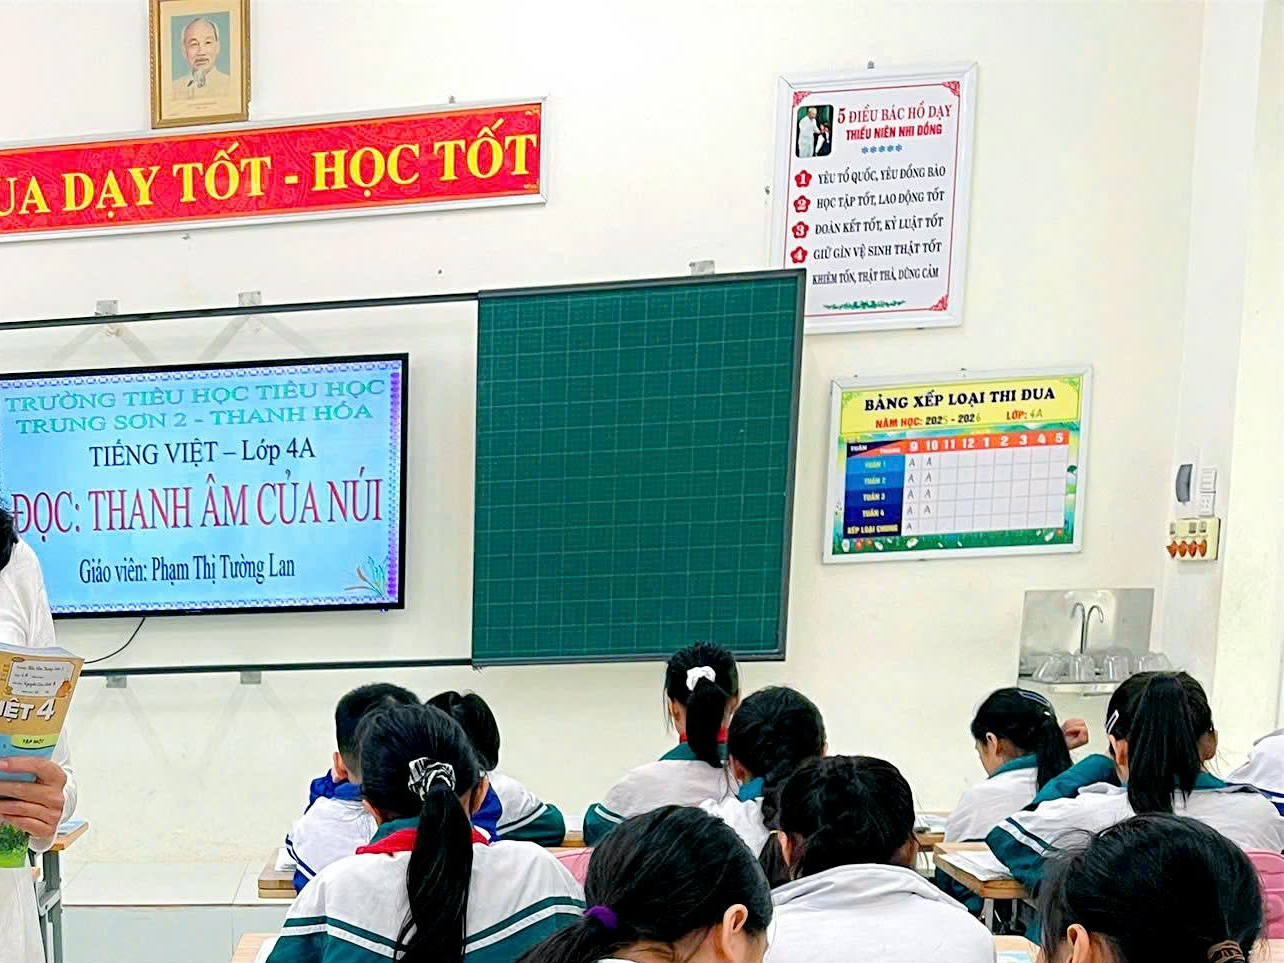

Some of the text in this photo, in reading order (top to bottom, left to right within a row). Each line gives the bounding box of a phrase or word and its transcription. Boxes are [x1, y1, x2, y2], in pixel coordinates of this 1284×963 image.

[838, 101, 951, 124] 5 ĐIỀU BÁC HỒ DẠY
[874, 125, 895, 138] NIÊN
[899, 127, 914, 136] NHI
[61, 166, 161, 218] DẠY
[173, 141, 272, 202] TỐT
[311, 144, 420, 198] HỌC
[434, 118, 538, 181] TỐT
[818, 170, 835, 184] YÊU
[880, 166, 898, 180] YÊU
[817, 198, 836, 211] HỌC
[838, 194, 856, 209] TẬP
[879, 194, 897, 204] LAO
[898, 190, 924, 206] ĐỘNG
[927, 187, 945, 201] TỐT
[843, 218, 861, 233] KẾT
[899, 215, 923, 231] LUẬT
[925, 213, 943, 228] TỐT
[868, 245, 892, 256] SINH
[895, 241, 920, 256] THẬT
[923, 238, 942, 252] TỐT
[5, 391, 115, 412] TRƯỜNG
[192, 386, 249, 404] HỌC
[325, 380, 385, 399] HỌC
[865, 387, 1055, 411] BẢNG XẾP LOẠI THI ĐUA
[16, 416, 106, 434] TRUNG
[114, 412, 165, 430] SƠN
[174, 412, 187, 428] 2
[210, 407, 306, 425] THANH
[89, 437, 316, 467] TIẾNG VIỆT Lớp 4A
[910, 442, 918, 452] 9
[926, 440, 938, 450] 10
[943, 439, 955, 449] 11
[962, 438, 975, 448] 12
[983, 437, 990, 447] 1
[1000, 436, 1009, 446] 2
[1019, 435, 1028, 445] 3
[10, 466, 383, 542] ĐỌC: THANH ÂM CỦA NÚI
[79, 553, 295, 586] Giáo viên: Phạm Thị Tường Lan
[37, 698, 56, 720] 4
